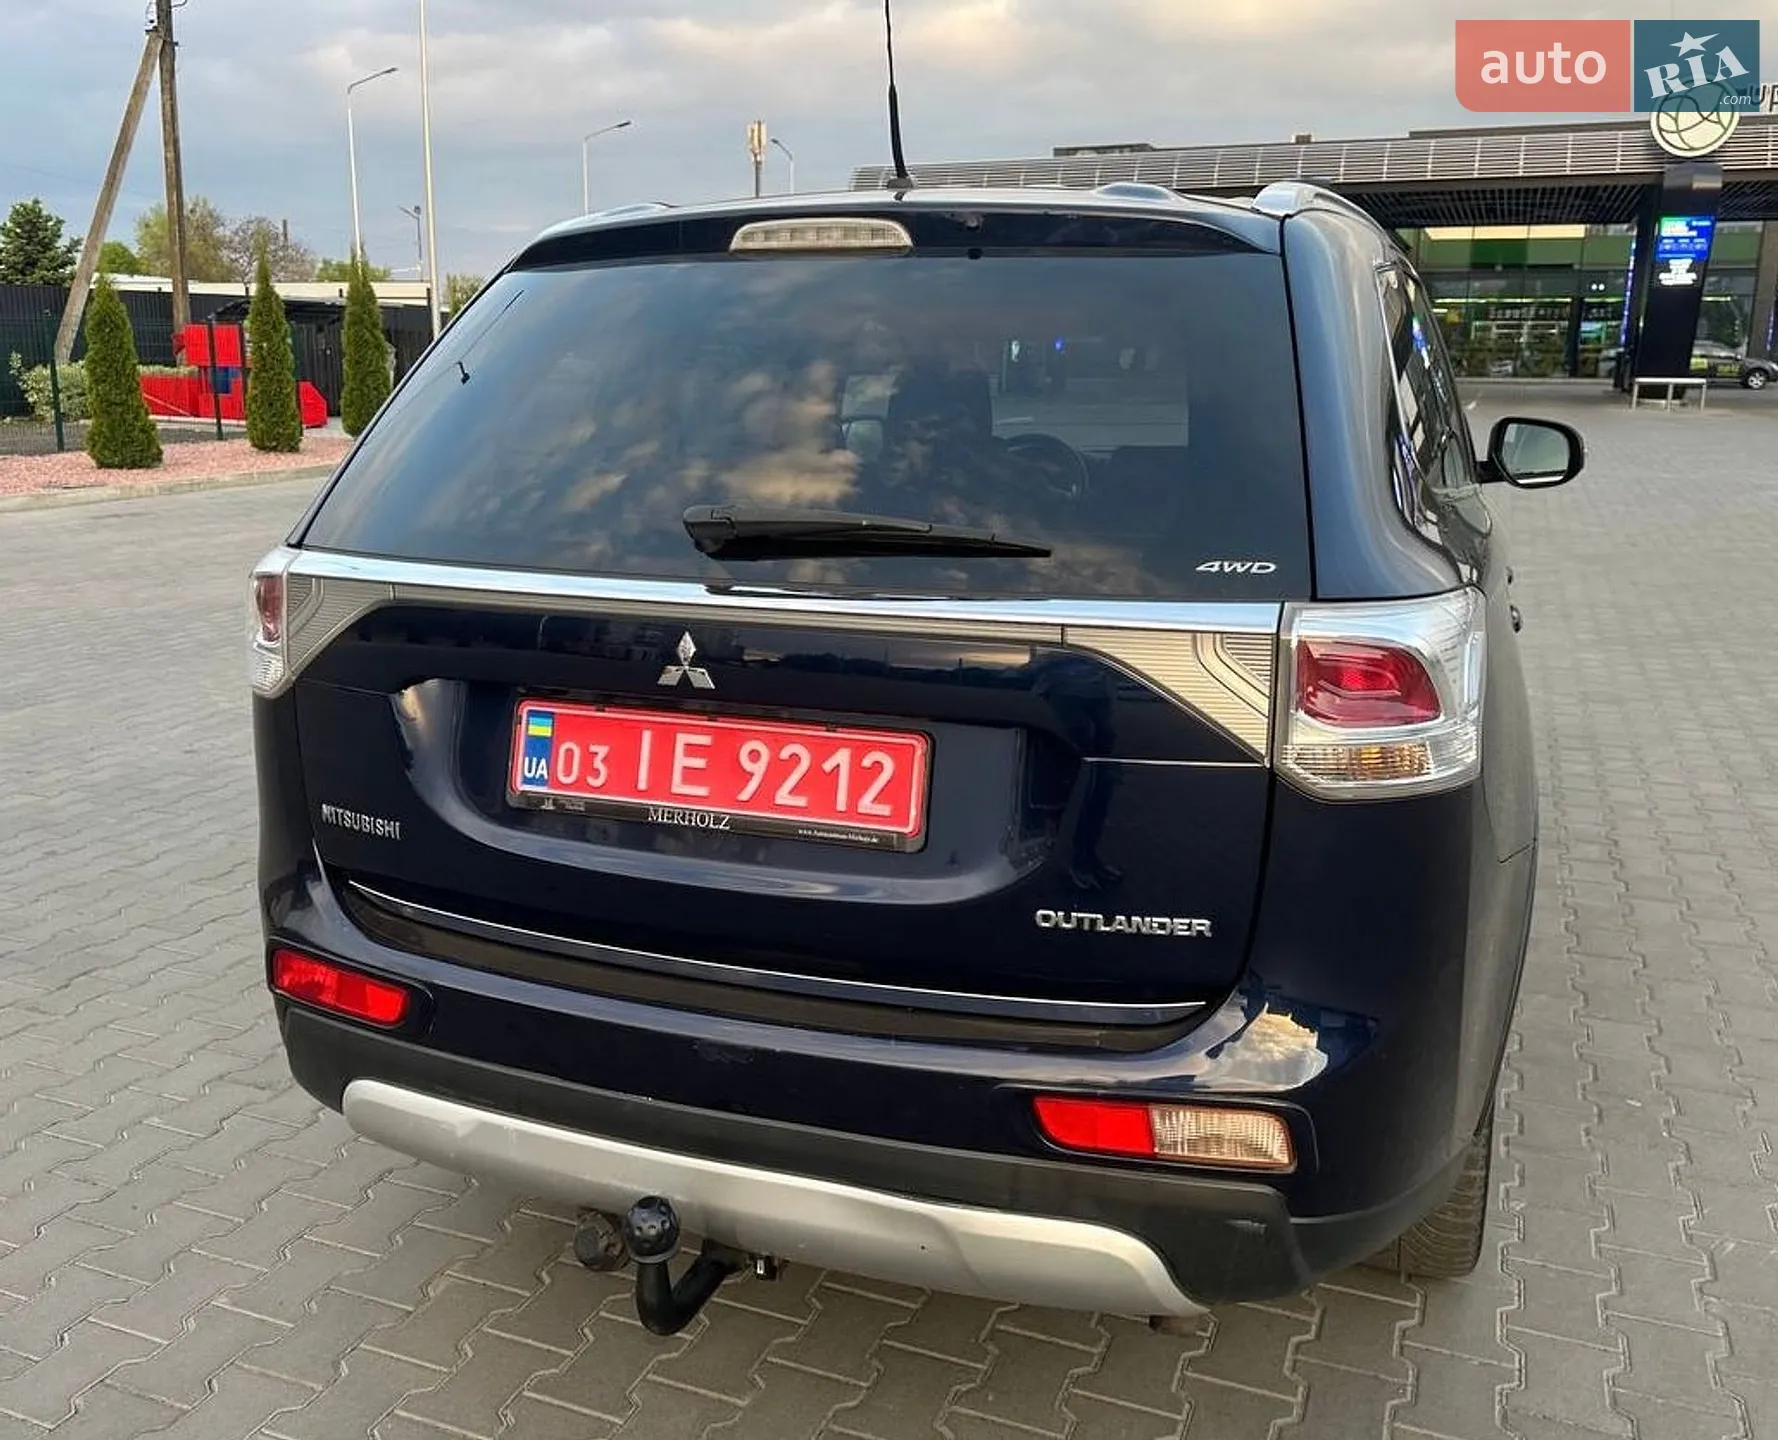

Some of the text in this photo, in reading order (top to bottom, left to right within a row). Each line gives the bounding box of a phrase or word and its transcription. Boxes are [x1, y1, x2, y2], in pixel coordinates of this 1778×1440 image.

[1195, 560, 1277, 574] 4WD
[524, 729, 896, 817] UA 03 IE 9212
[647, 806, 731, 830] MERHOLZ
[1035, 909, 1213, 938] OUTLANDER
